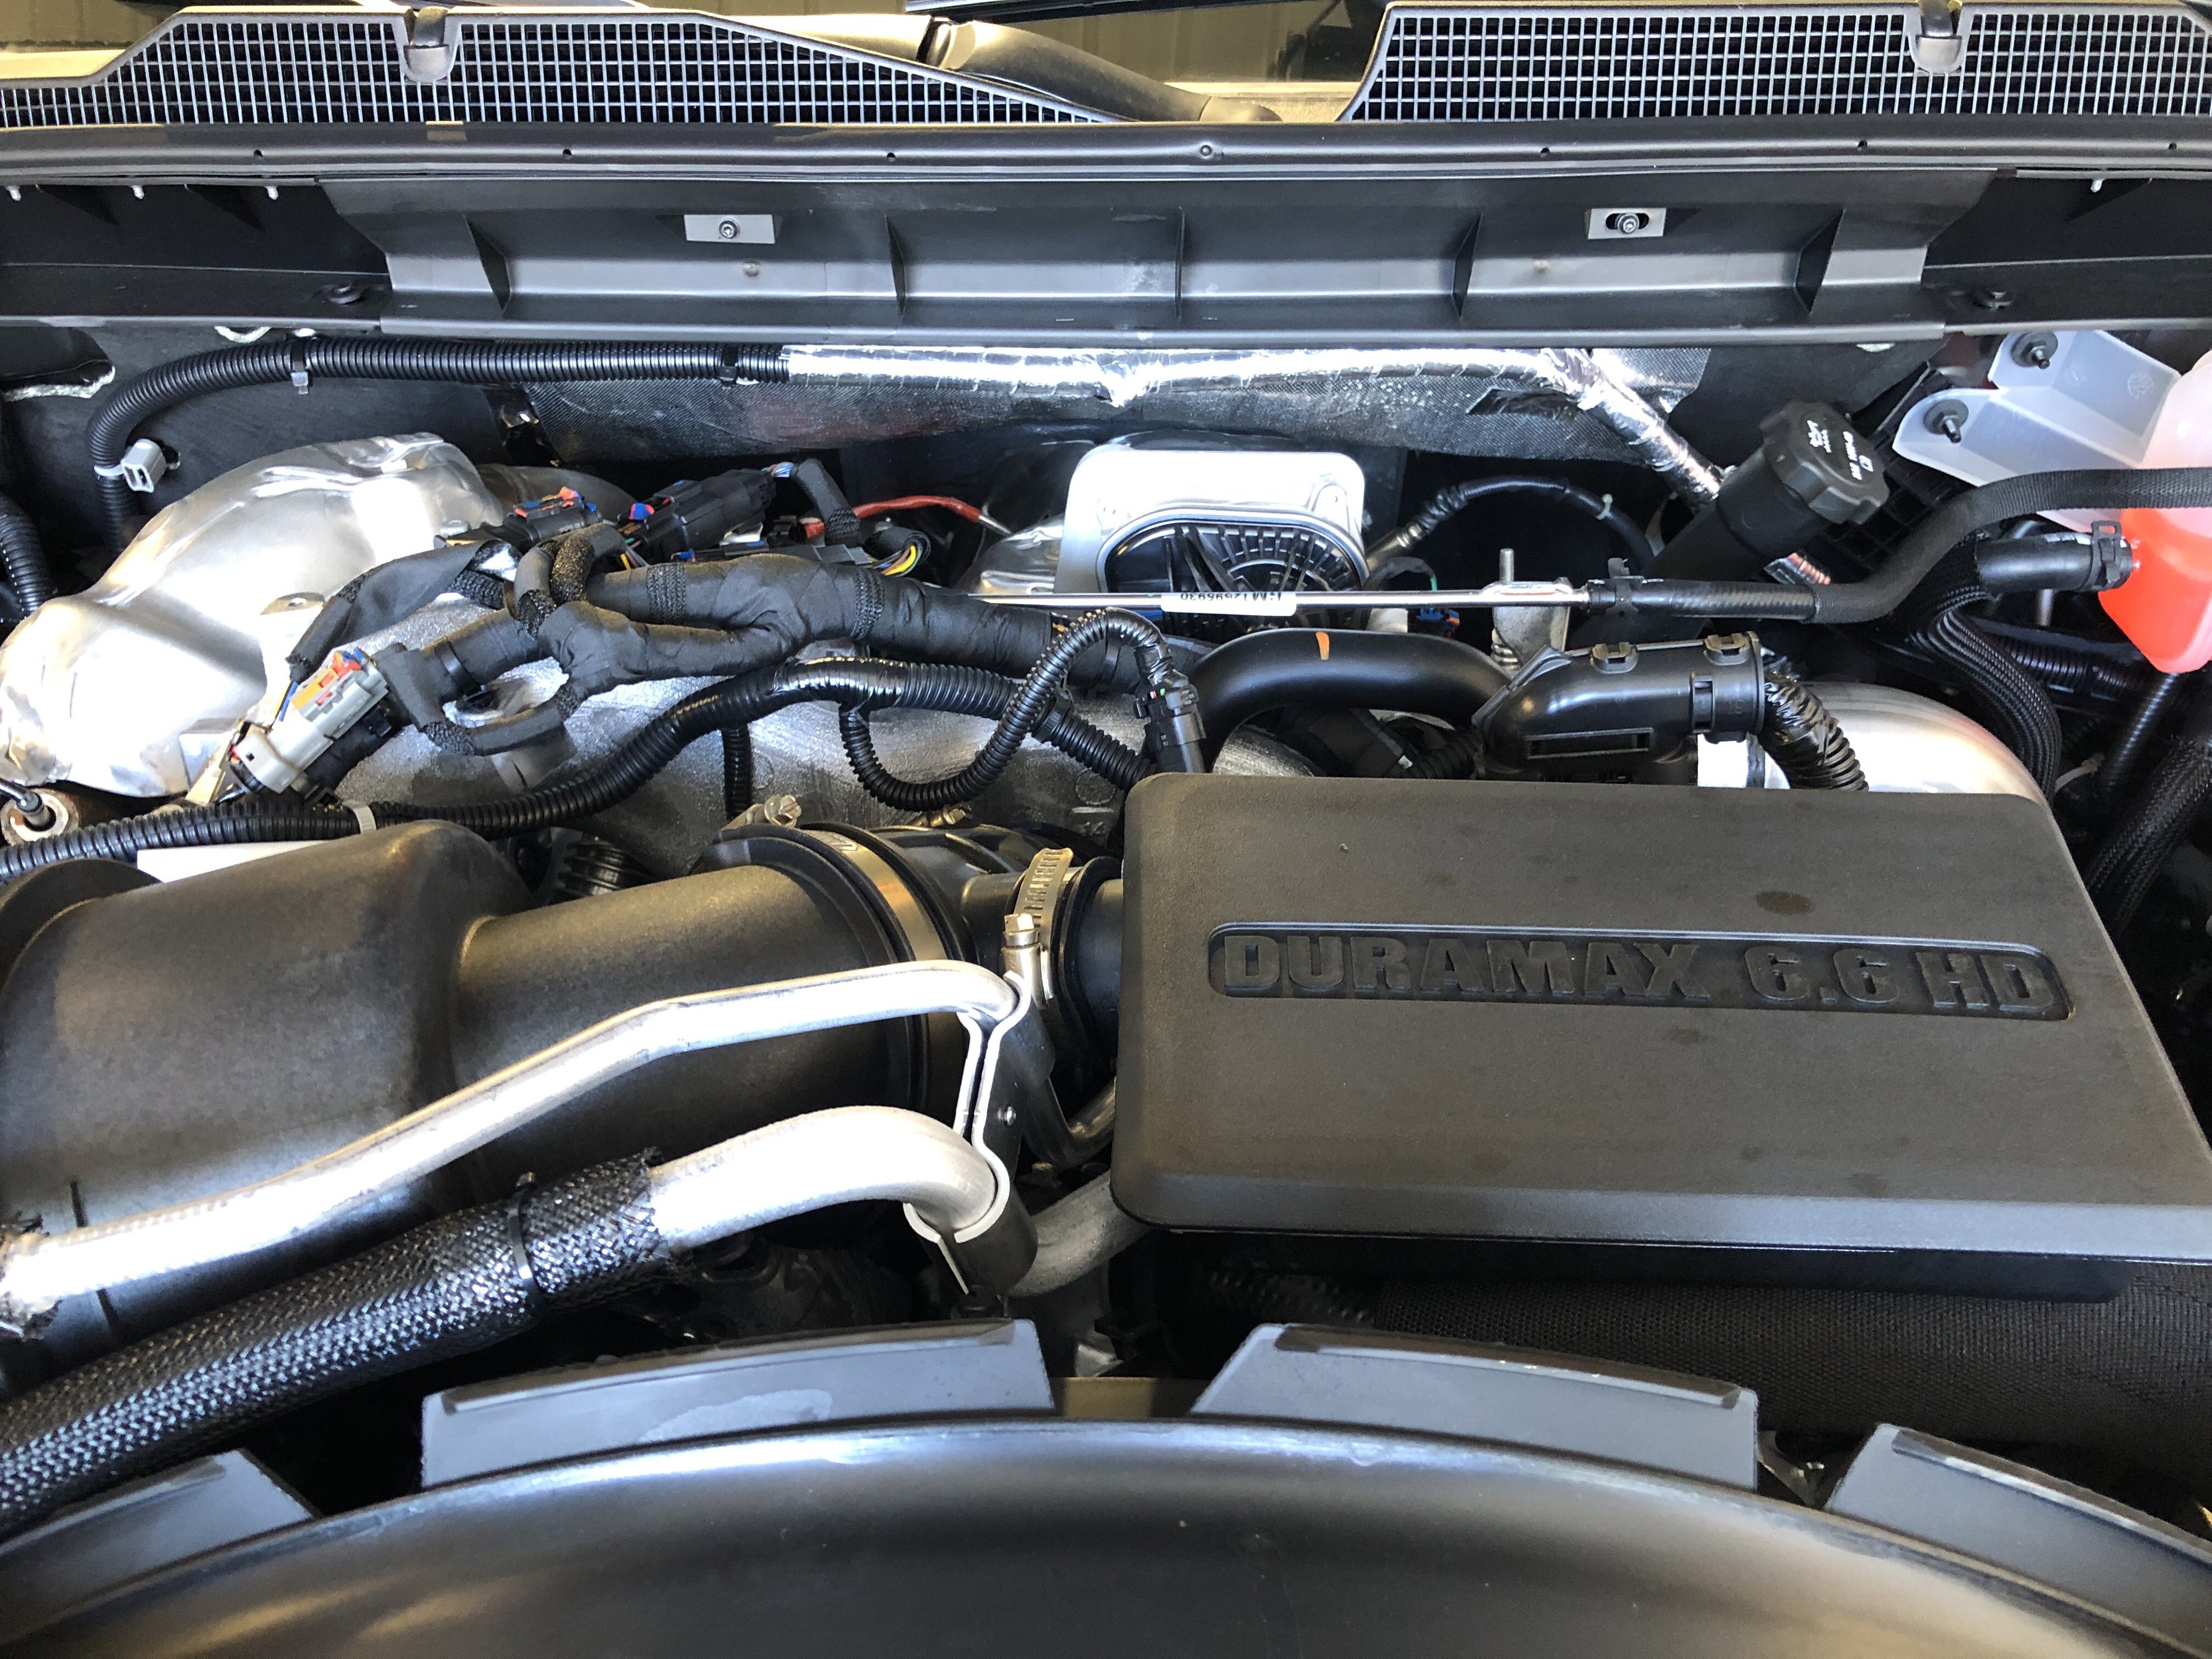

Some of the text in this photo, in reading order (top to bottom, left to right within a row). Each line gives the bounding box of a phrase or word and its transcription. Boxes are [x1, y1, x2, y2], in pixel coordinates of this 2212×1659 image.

[1224, 934, 2054, 1012] DURAMAX 6.6 HD
